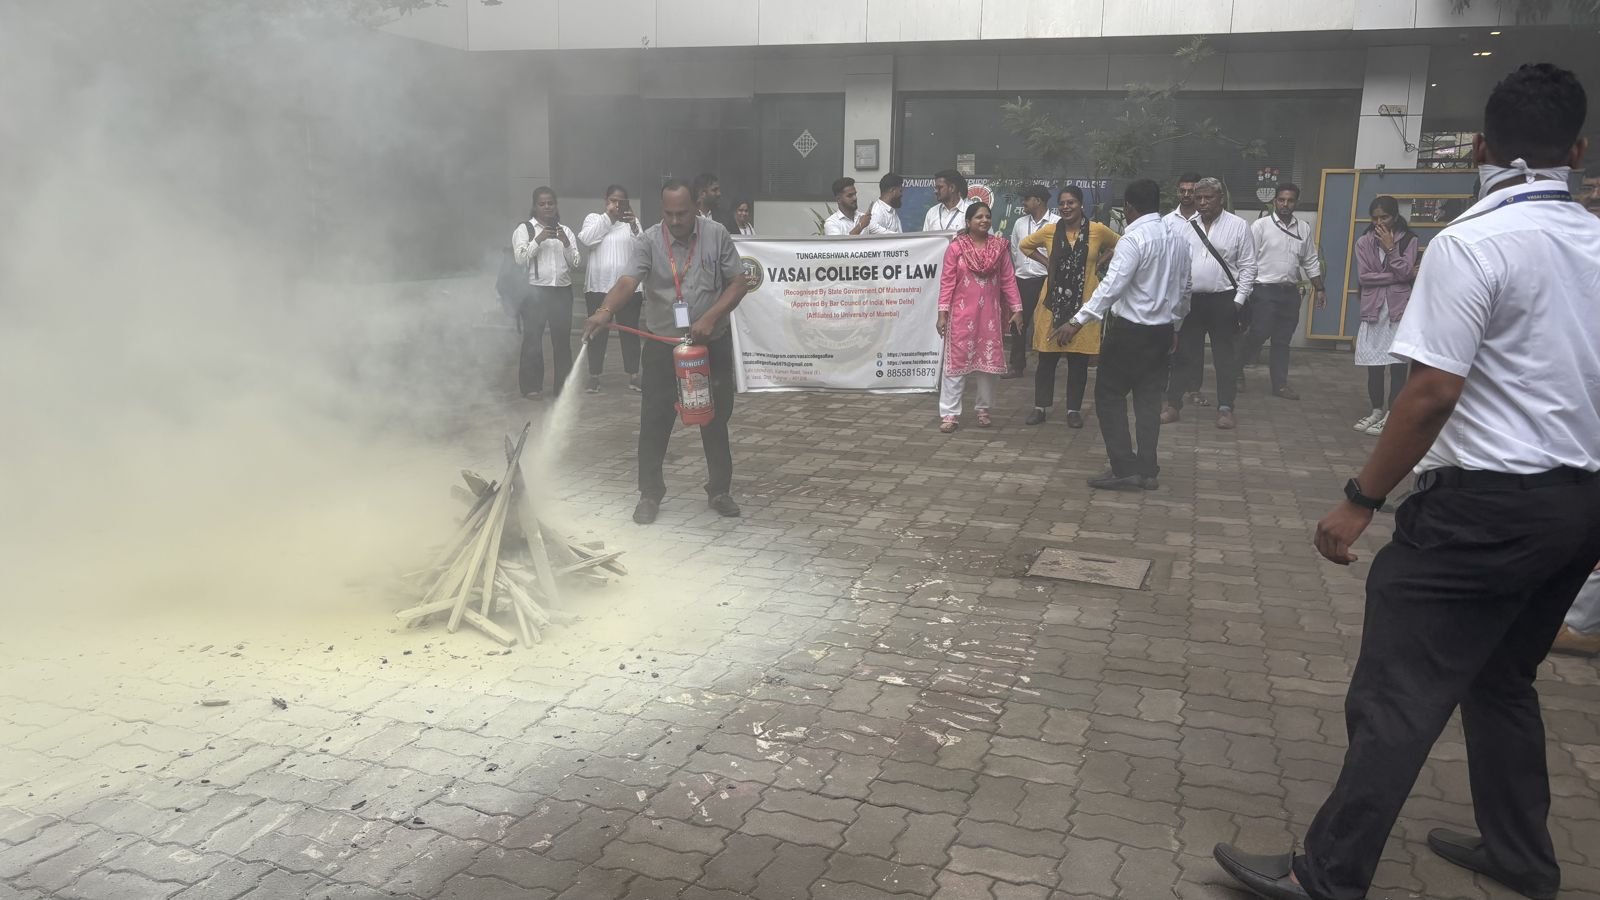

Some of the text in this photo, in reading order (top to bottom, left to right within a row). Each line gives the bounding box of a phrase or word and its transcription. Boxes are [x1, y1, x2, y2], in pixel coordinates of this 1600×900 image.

[796, 250, 909, 260] TUNGARESHWAR ACADEMY TRUST'S
[767, 263, 938, 282] VASAI COLLEGE OF LAW
[843, 287, 877, 295] Government
[806, 312, 833, 320] (Affiliated
[840, 311, 868, 320] University
[876, 310, 900, 318] Mumbai)
[886, 368, 936, 378] 8855815879
